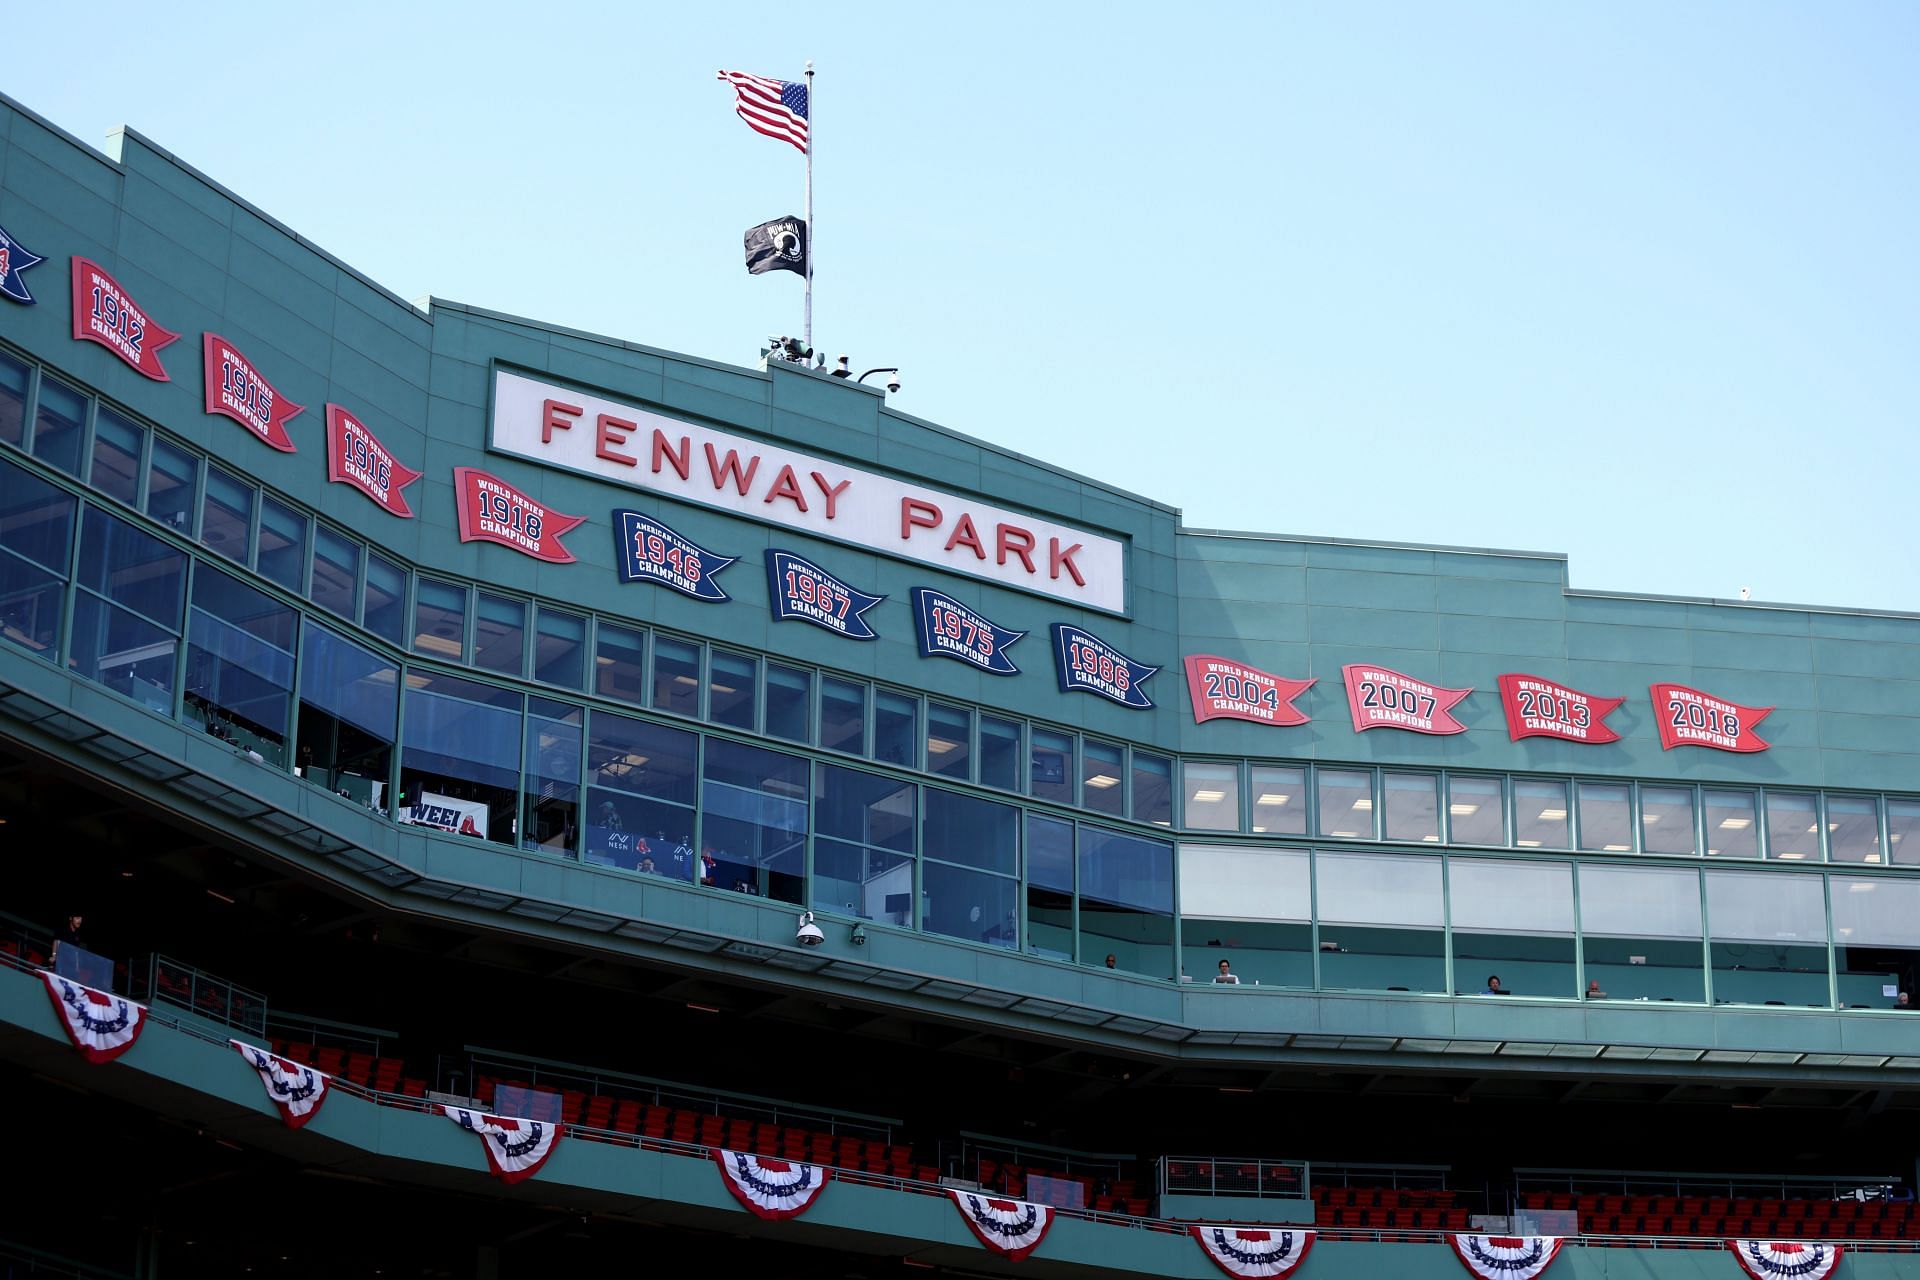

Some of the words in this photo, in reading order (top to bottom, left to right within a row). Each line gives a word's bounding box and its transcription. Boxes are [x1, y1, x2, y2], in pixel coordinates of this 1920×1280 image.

[92, 273, 119, 300] WORLD
[121, 297, 146, 326] SERIES
[92, 287, 144, 353] 1912
[92, 318, 140, 364] CHAMPIONS
[222, 348, 248, 374] WORLD
[250, 371, 272, 399] SERIES
[223, 361, 272, 423] 1915
[223, 392, 268, 435] CHAMPIONS
[344, 419, 368, 443] WORLD
[370, 441, 392, 467] SERIES
[345, 432, 390, 491] 1916
[345, 462, 388, 502] CHAMPIONS
[478, 480, 510, 498] WORLD
[513, 495, 544, 517] SERIES
[542, 399, 852, 519] FENWAY
[901, 496, 1086, 587] PARK
[479, 491, 542, 540] 1918
[481, 520, 540, 551] CHAMPIONS
[637, 522, 671, 542] AMERICAN
[674, 539, 699, 557] LEAGUE
[635, 532, 701, 582] 1946
[640, 561, 696, 591] CHAMPIONS
[788, 563, 821, 582] AMERICAN
[824, 578, 848, 596] LEAGUE
[786, 571, 851, 619] 1967
[791, 600, 845, 630] CHAMPIONS
[933, 608, 993, 656] 1975
[934, 599, 966, 618] AMERICAN
[968, 615, 991, 632] LEAGUE
[938, 636, 989, 665] CHAMPIONS
[1070, 643, 1130, 691] 1986
[1072, 635, 1103, 652] AMERICAN
[1105, 650, 1127, 667] LEAGUE
[1076, 671, 1125, 699] CHAMPIONS
[1205, 673, 1279, 710] 2004
[1208, 664, 1240, 676] WORLD
[1244, 671, 1275, 686] SERIES
[1363, 672, 1397, 684] WORLD
[1400, 679, 1432, 695] SERIES
[1518, 681, 1552, 694] WORLD
[1555, 688, 1586, 704] SERIES
[1214, 700, 1273, 719] CHAMPIONS
[1360, 682, 1437, 719] 2007
[1370, 709, 1432, 729] CHAMPIONS
[1518, 691, 1590, 728] 2013
[1669, 691, 1702, 704] WORLD
[1704, 699, 1736, 714] SERIES
[1669, 700, 1739, 738] 2018
[1526, 718, 1586, 738] CHAMPIONS
[1677, 728, 1736, 747] CHAMPIONS
[411, 804, 461, 827] WEEI
[609, 841, 628, 850] NESN
